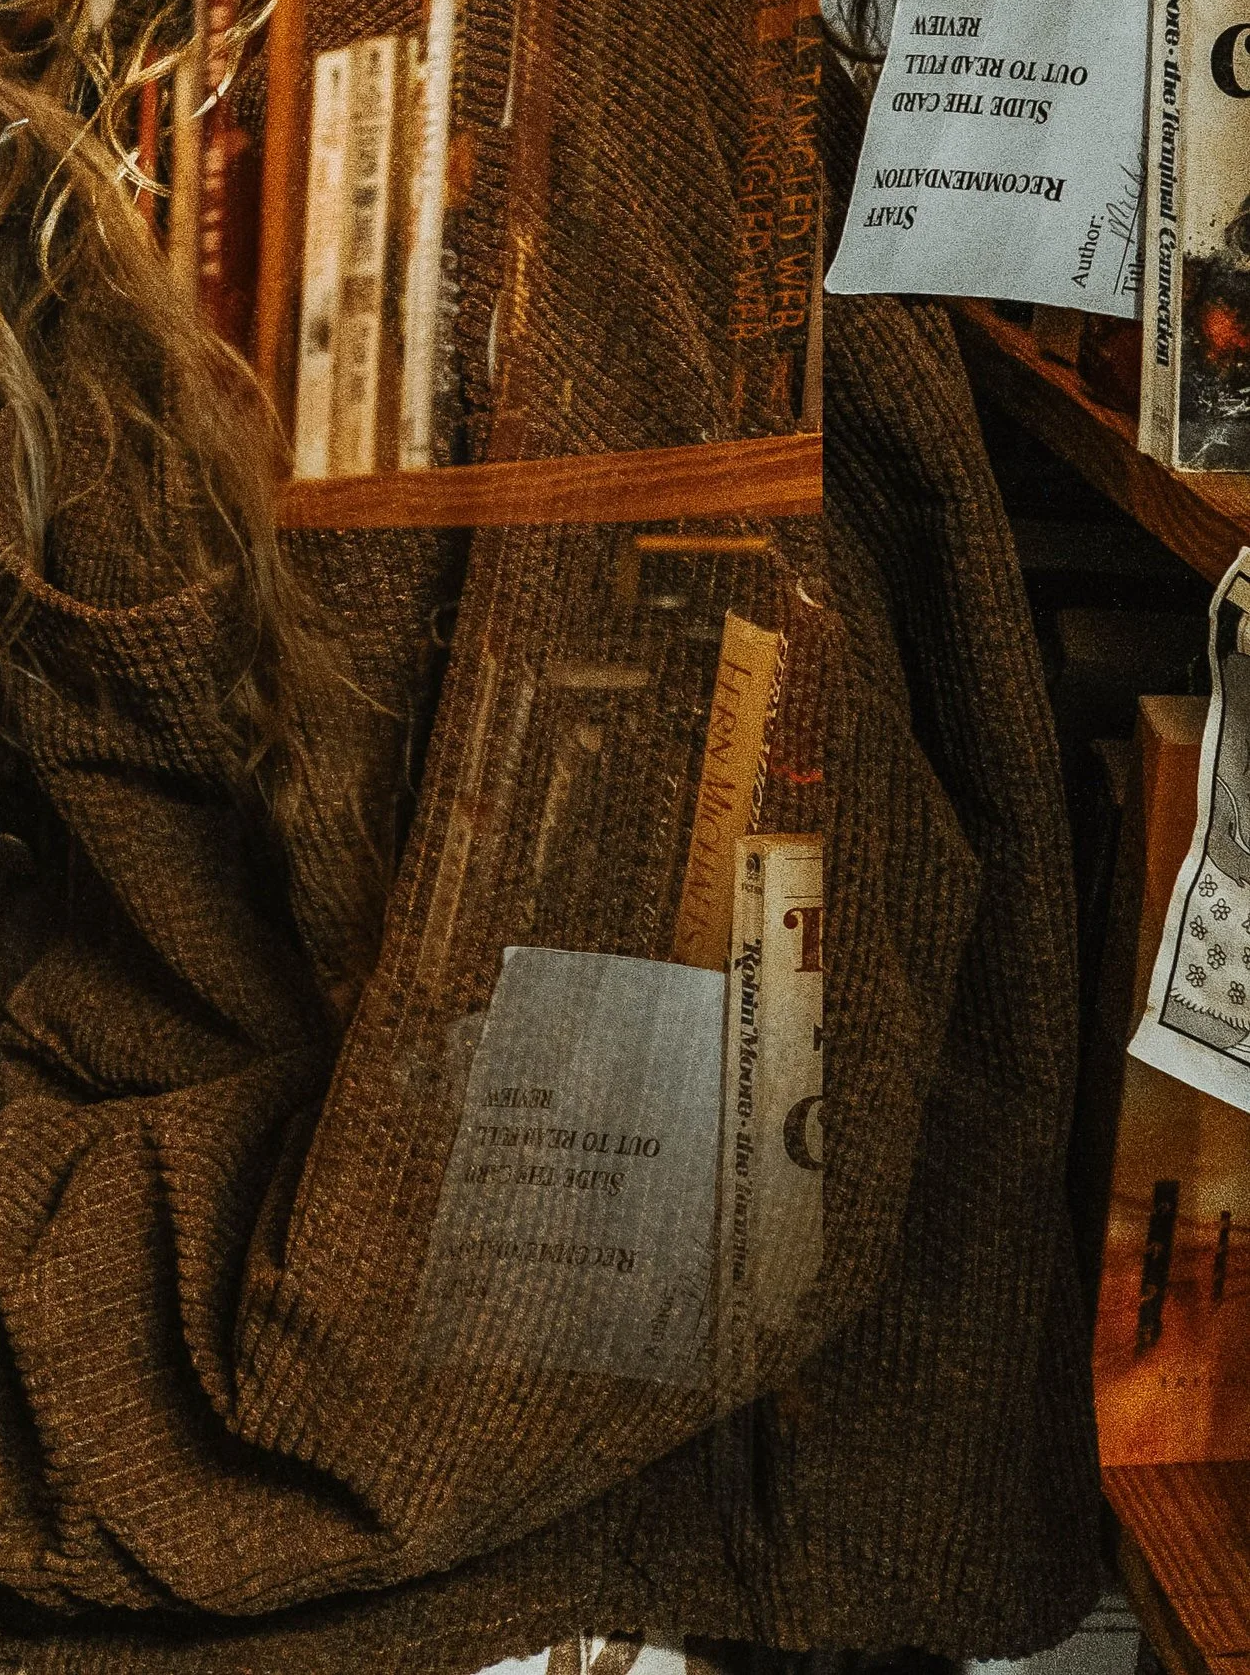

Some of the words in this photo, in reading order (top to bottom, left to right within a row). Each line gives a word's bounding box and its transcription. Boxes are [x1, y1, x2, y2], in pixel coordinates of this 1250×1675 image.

[910, 15, 982, 38] REVIEW
[905, 53, 949, 75] FULL
[951, 55, 1005, 77] READ
[1009, 61, 1038, 82] TO
[1042, 64, 1088, 86] OUT
[1163, 58, 1181, 107] the
[892, 91, 941, 113] CARD
[944, 92, 985, 115] THE
[990, 95, 1052, 126] SLIDE
[1159, 109, 1181, 223] Terminal
[872, 168, 1067, 203] RECOMMENDATION
[863, 205, 918, 231] STAFF
[1069, 213, 1106, 290] Author:
[771, 251, 812, 330] WEB
[1154, 227, 1179, 367] Connection
[583, 1132, 612, 1153] TO
[616, 1135, 662, 1157] OUT
